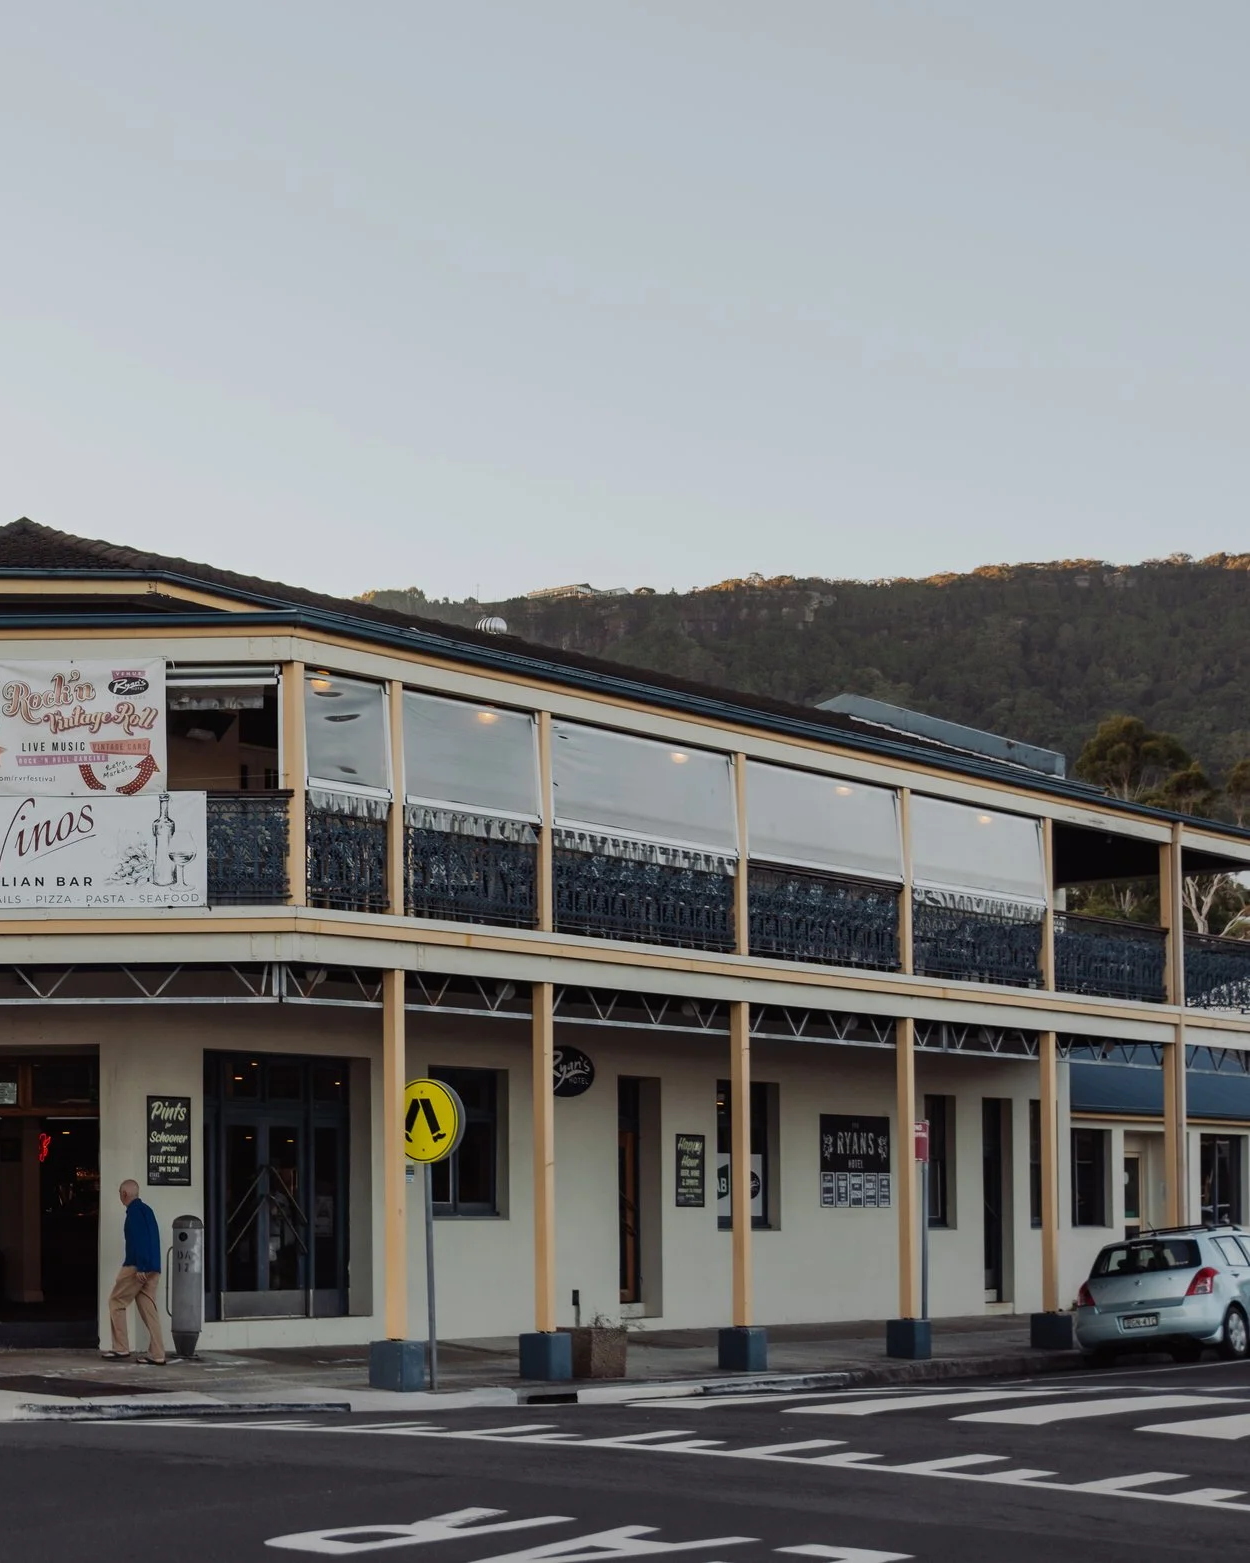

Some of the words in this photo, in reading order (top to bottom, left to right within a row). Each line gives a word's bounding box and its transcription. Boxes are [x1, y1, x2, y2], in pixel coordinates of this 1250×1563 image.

[112, 679, 146, 694] Ryan's
[43, 705, 111, 734] Vintage
[112, 702, 158, 736] Roll
[22, 742, 45, 752] LIVE
[52, 742, 85, 751] MUSIC
[92, 743, 124, 751] VINTAGE
[128, 742, 147, 751] CARS
[106, 760, 126, 770] Retro
[103, 765, 133, 778] Markets
[56, 877, 93, 887] BAR
[36, 895, 71, 903] PIZZA
[86, 895, 125, 903] PASTA
[139, 894, 199, 903] SEAFOOD
[151, 1101, 186, 1121] Pints
[150, 1131, 188, 1143] Schooner
[678, 1137, 702, 1155] Happy
[837, 1132, 874, 1155] RYANS
[150, 1155, 166, 1163] EVERY
[167, 1156, 188, 1164] SUNDAY
[682, 1155, 699, 1166] Hour
[848, 1160, 863, 1168] HOTEL
